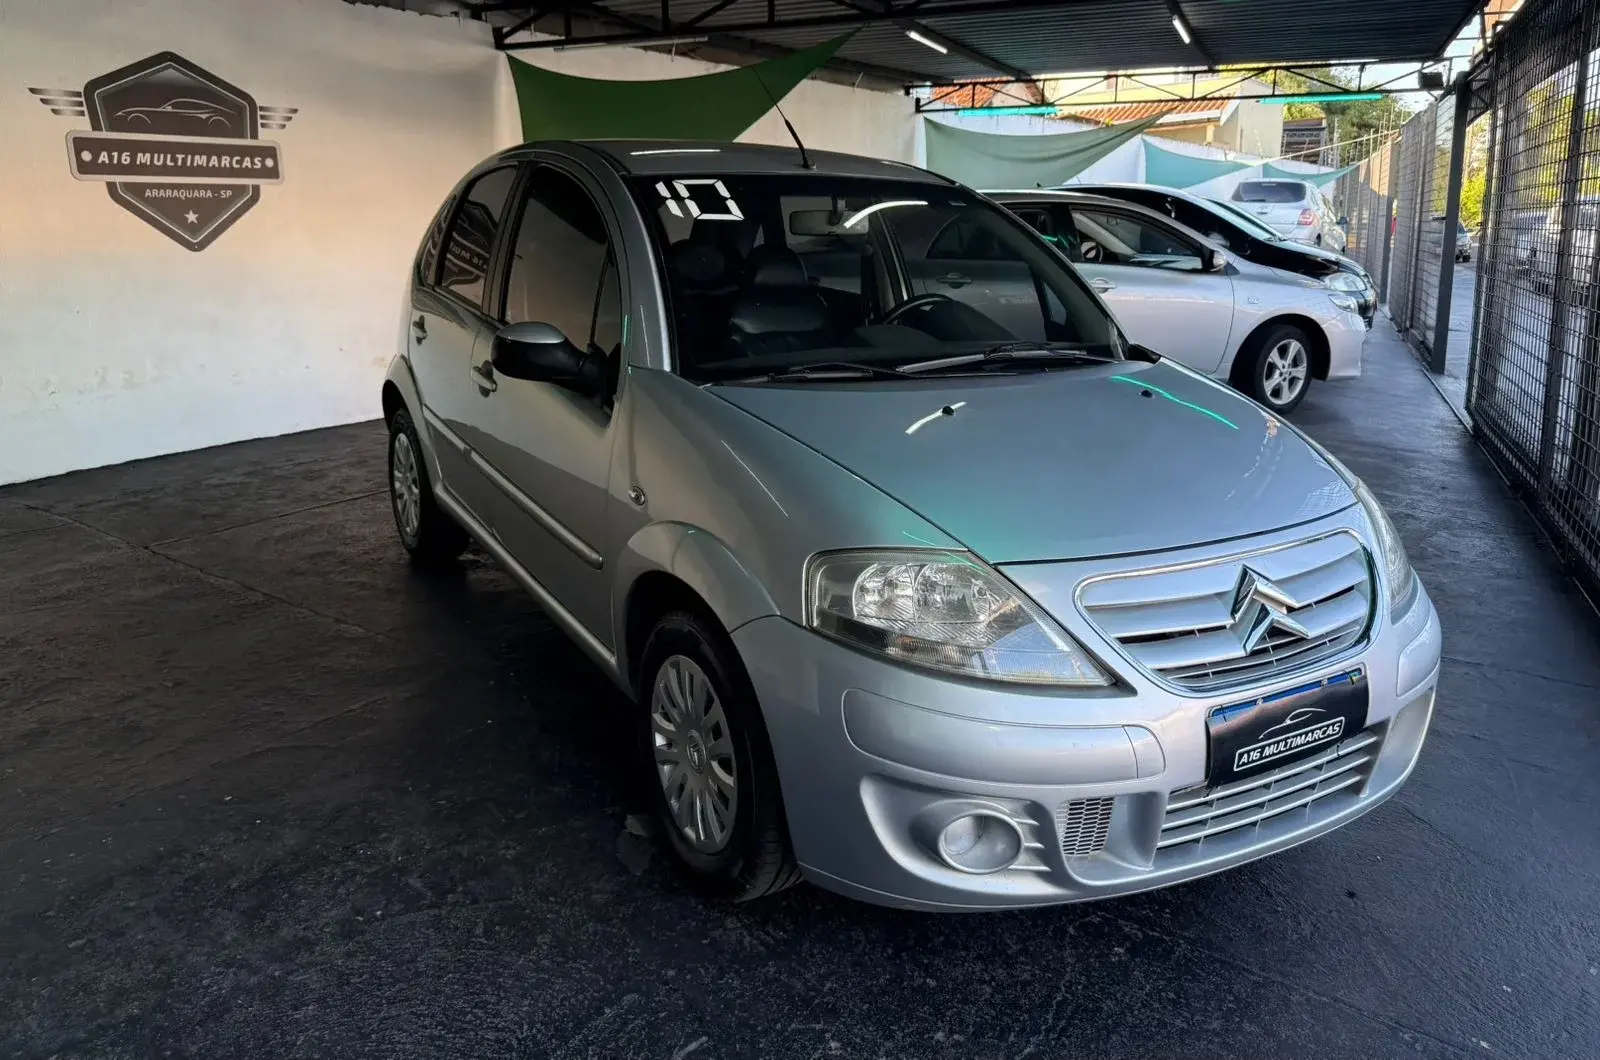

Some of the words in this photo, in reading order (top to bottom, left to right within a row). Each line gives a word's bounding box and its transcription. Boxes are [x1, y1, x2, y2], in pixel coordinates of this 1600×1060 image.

[97, 151, 131, 165] A16
[136, 152, 262, 169] MULTIMARCAS
[144, 188, 213, 200] ARARAQUARA
[220, 189, 233, 198] SP
[1239, 748, 1262, 765] A16
[1262, 722, 1341, 757] MULTIMARCAS
